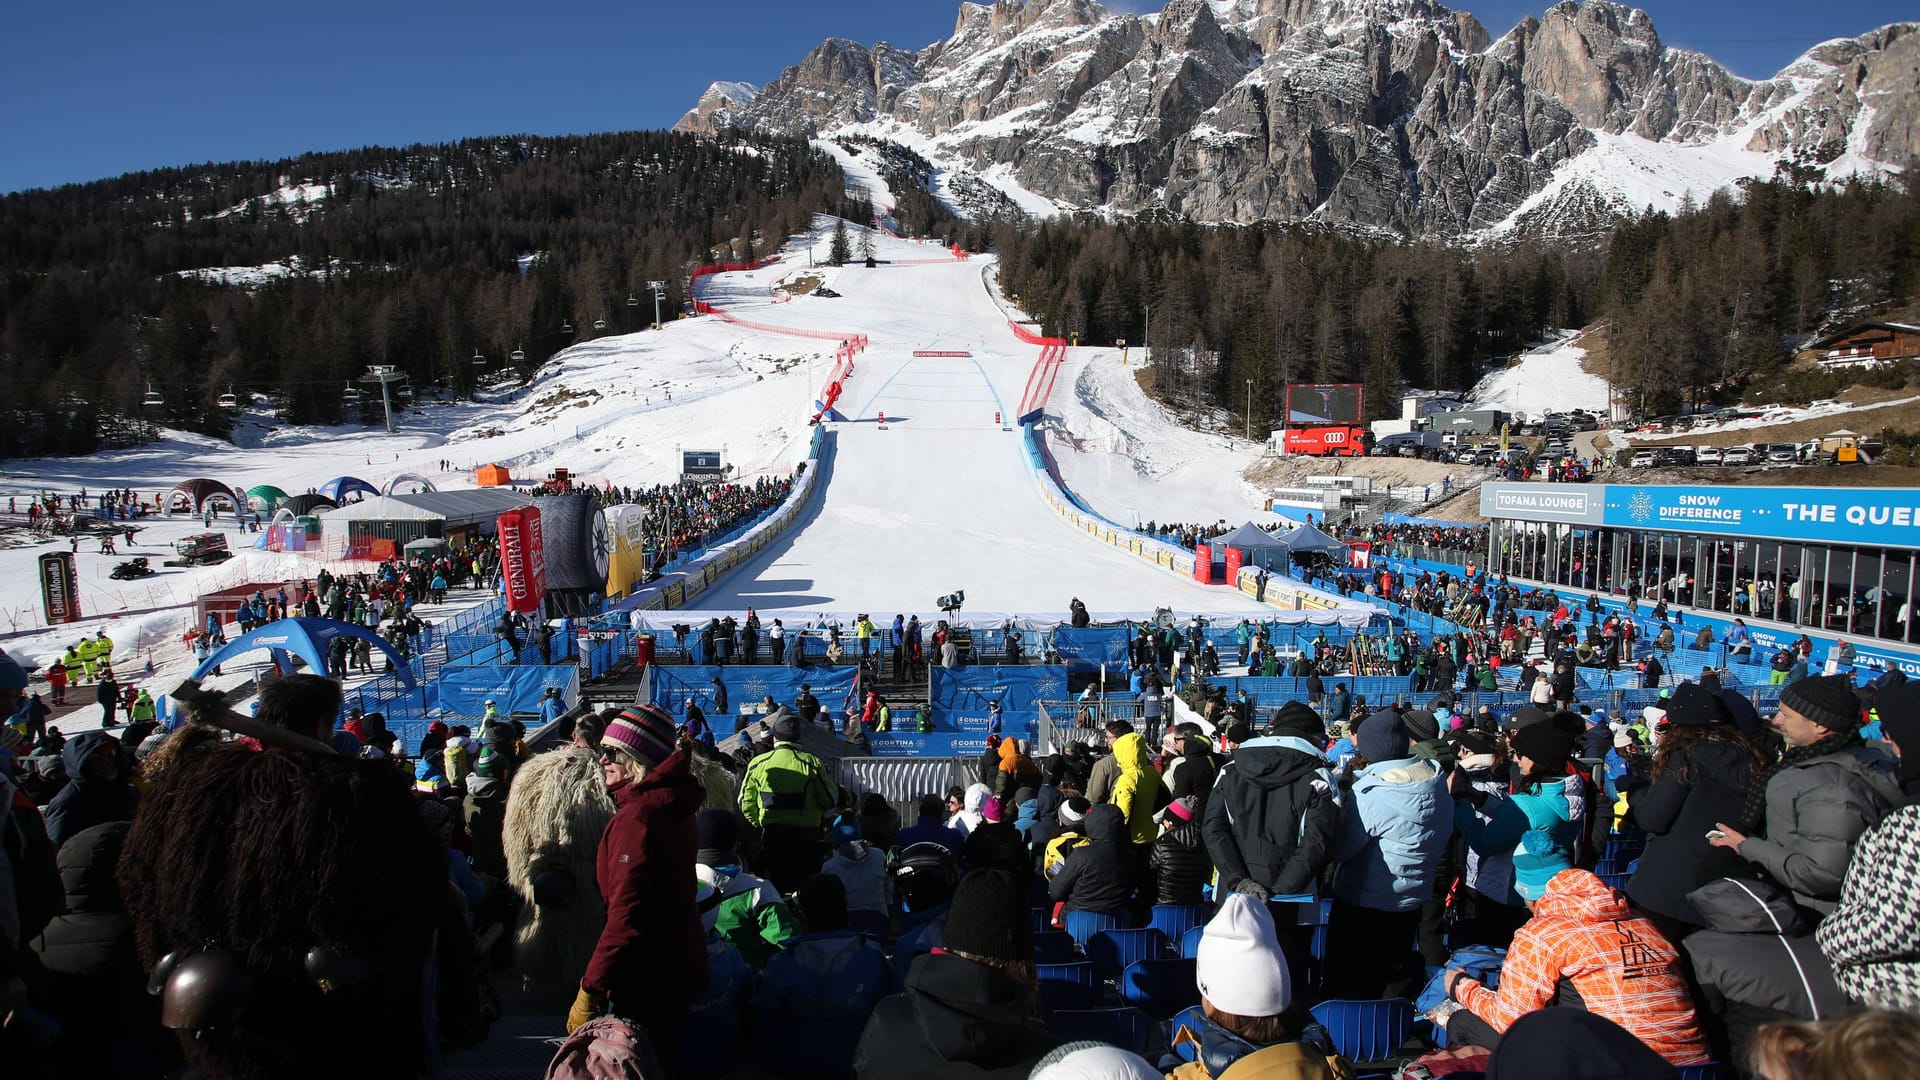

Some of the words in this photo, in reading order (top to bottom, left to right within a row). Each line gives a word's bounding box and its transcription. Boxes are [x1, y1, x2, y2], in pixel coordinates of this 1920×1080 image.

[1499, 495, 1537, 506] TOFANA
[1540, 497, 1583, 509] LOUNGE
[1679, 495, 1720, 506] SNOW
[1659, 506, 1742, 520] DIFFERENCE
[1782, 503, 1837, 523] THE
[504, 525, 528, 600] GENERALI
